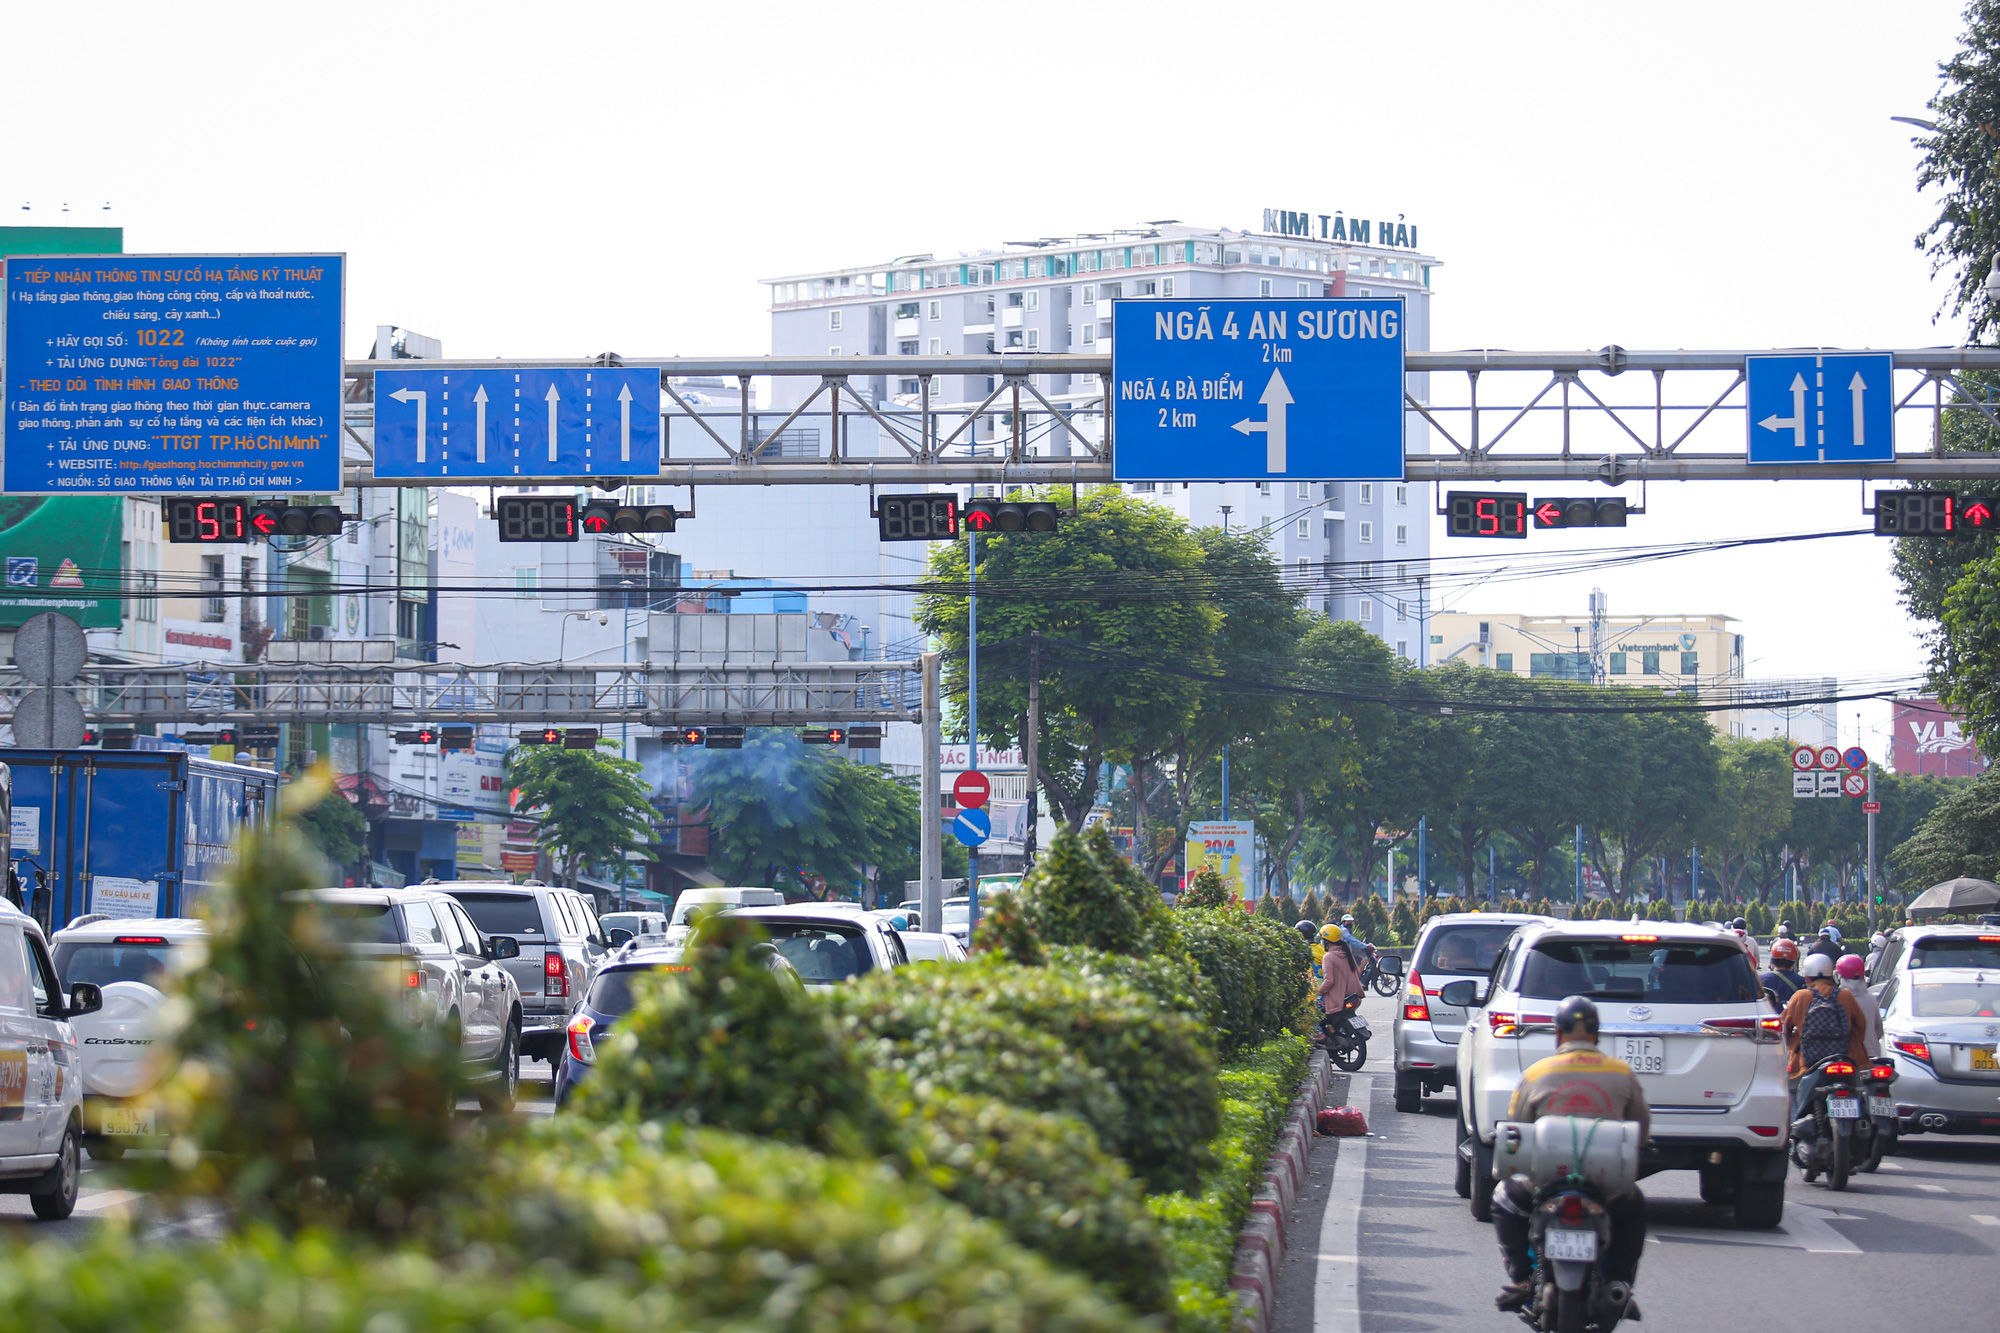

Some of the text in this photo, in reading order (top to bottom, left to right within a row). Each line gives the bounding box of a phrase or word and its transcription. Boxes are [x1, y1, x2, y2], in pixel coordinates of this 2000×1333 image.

[1263, 208, 1417, 249] KIM TÂM HẢI
[24, 264, 323, 285] TIẾP NHẬN THÔNG TIN SỰ CỐ HẠ TẦNG KỸ THUẬT
[36, 290, 57, 303] tầng
[60, 292, 80, 303] giao
[136, 291, 164, 302] thông
[167, 290, 191, 302] công
[226, 288, 243, 301] cấp
[245, 289, 257, 299] và
[260, 288, 284, 299] thoát
[103, 308, 130, 319] chiếu
[165, 309, 182, 320] cây
[1155, 306, 1398, 340] NGÃ 4 AN SƯƠNG
[57, 334, 80, 346] HÃY
[84, 337, 102, 349] GỌI
[137, 329, 184, 346] 1022
[251, 337, 273, 345] cước
[276, 337, 297, 346] cuộc
[1262, 343, 1292, 363] 2 km
[57, 355, 74, 368] TẢI
[79, 355, 104, 368] ỨNG
[183, 356, 199, 367] đài
[29, 376, 239, 391] THEO DÕI TÌNH HÌNH GIAO THÔNG
[1121, 373, 1243, 400] NGÃ 4 BÀ ĐIỂM
[43, 400, 56, 411] đồ
[60, 400, 77, 411] tình
[81, 402, 107, 413] trạng
[111, 402, 131, 413] giao
[135, 401, 163, 413] thông
[167, 401, 189, 410] theo
[193, 400, 212, 410] thời
[218, 401, 239, 412] gian
[19, 419, 39, 430] giao
[76, 416, 100, 429] phản
[104, 417, 122, 427] ánh
[130, 419, 143, 429] sự
[147, 415, 160, 426] cố
[164, 417, 176, 428] hạ
[180, 415, 202, 428] tầng
[207, 416, 219, 426] và
[224, 416, 242, 426] các
[247, 417, 265, 428] tiện
[271, 414, 285, 426] ích
[1158, 408, 1196, 427] 2 km
[59, 437, 76, 450] TẢI
[83, 437, 108, 450] ỨNG
[257, 435, 282, 449] Chí
[59, 459, 116, 469] WEBSITE:
[58, 473, 94, 486] NGUỒN:
[98, 474, 110, 486] SỞ
[114, 478, 136, 486] GIAO
[141, 475, 172, 486] THÔNG
[176, 475, 194, 488] VẬN
[200, 474, 213, 486] TẢI
[249, 474, 264, 485] CHÍ
[268, 477, 291, 485] MINH
[197, 503, 243, 539] 51
[1475, 499, 1524, 534] 51
[1618, 643, 1679, 652] Vietcombank
[988, 752, 1013, 764] NHI
[1799, 753, 1809, 764] 80
[1825, 753, 1835, 764] 60
[1204, 839, 1236, 854] 30/4
[1626, 1040, 1652, 1055] 51F
[1618, 1056, 1662, 1071] 79.98
[107, 1123, 149, 1134] 930.74
